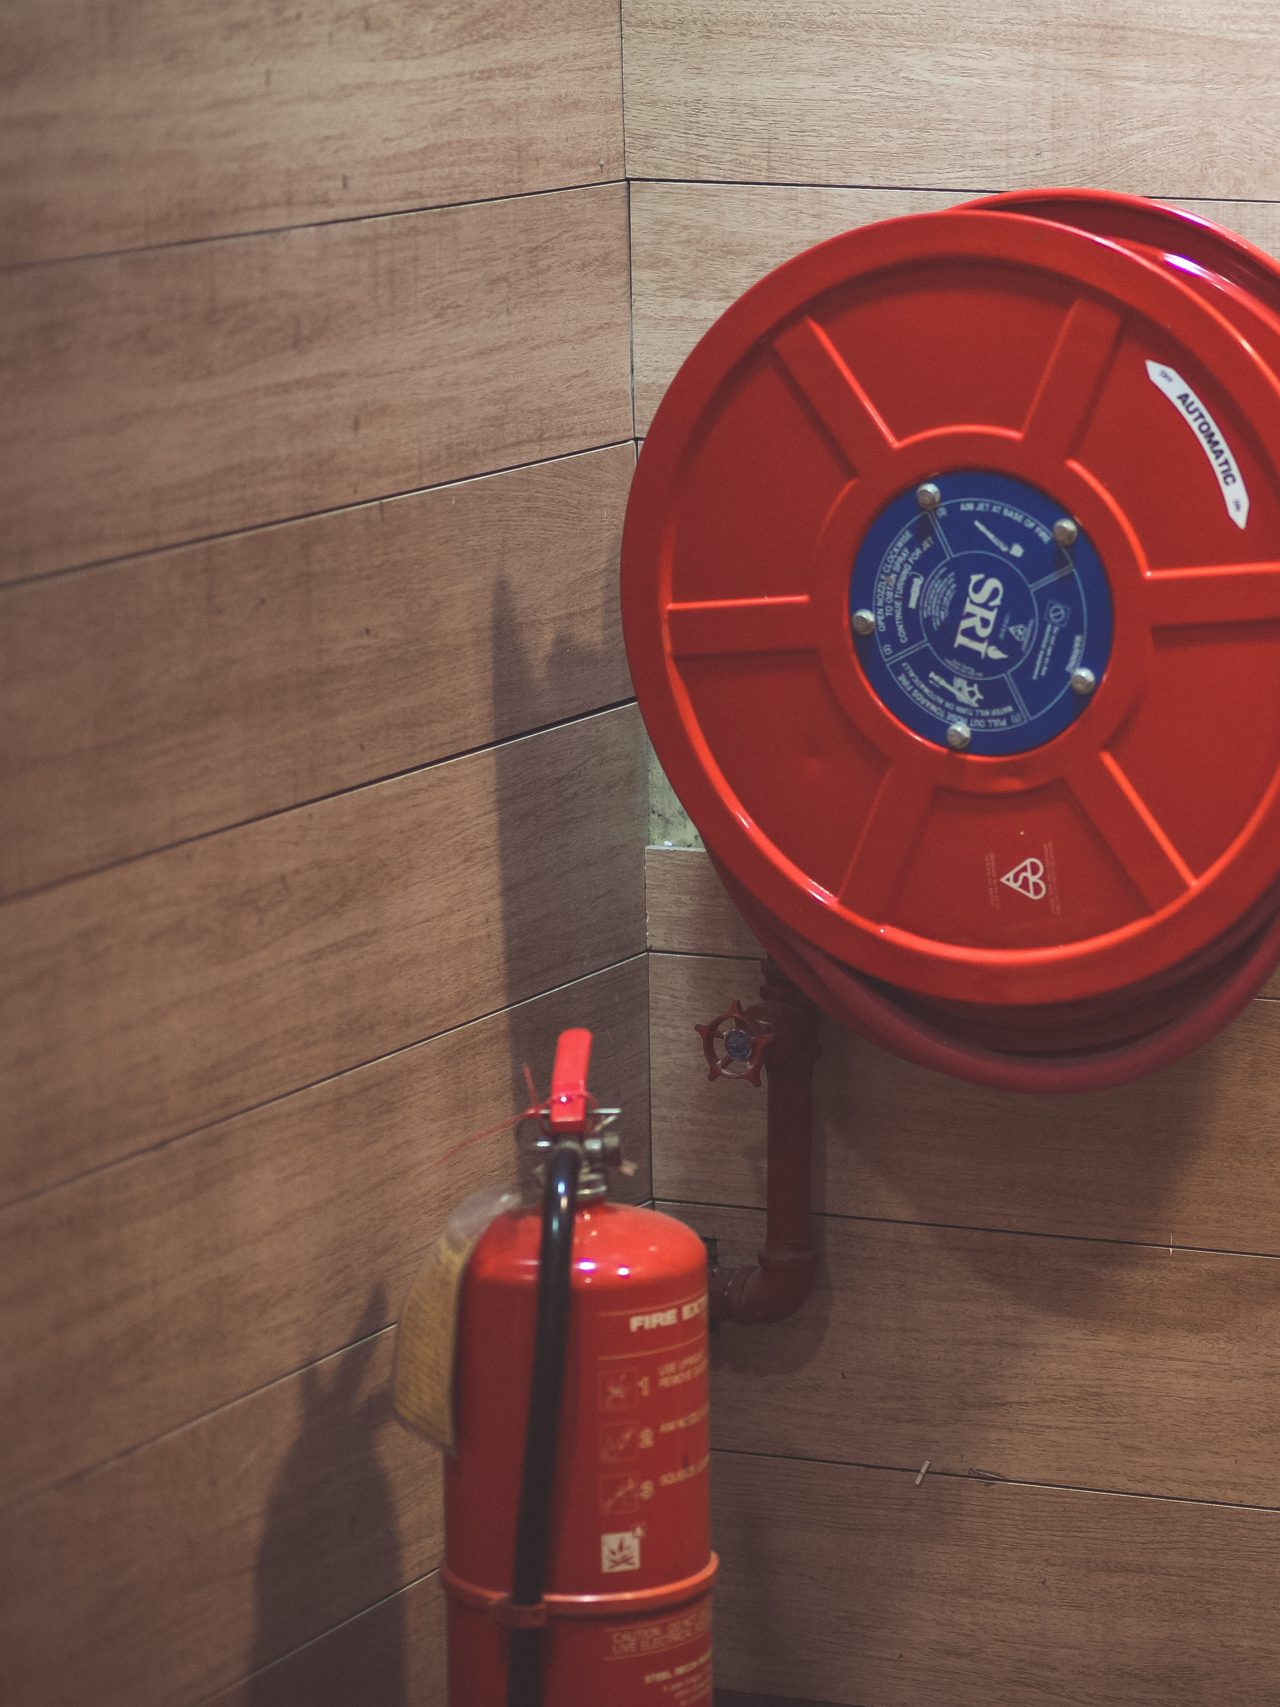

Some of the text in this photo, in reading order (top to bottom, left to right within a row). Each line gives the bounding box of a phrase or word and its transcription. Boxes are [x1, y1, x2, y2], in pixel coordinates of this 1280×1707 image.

[1177, 393, 1237, 486] AUTOMATIC
[976, 502, 990, 512] JET
[991, 504, 1001, 513] AT
[1002, 507, 1023, 523] BASE
[1023, 518, 1035, 529] OF
[1034, 526, 1051, 544] FIRE
[883, 530, 913, 572] CLOCKWISE
[877, 573, 887, 605] NOZZLE
[886, 546, 910, 615] TO OBTAIN SPRAY
[895, 535, 933, 643] CONTINUE TURNING FOR JET
[877, 608, 886, 631] OPEN
[953, 573, 1008, 660] SRI
[897, 673, 913, 691] FIRE
[901, 662, 944, 704] AUTOMATICALLY
[911, 690, 944, 717] TOWARDS
[969, 718, 985, 726] OUT
[630, 1308, 678, 1333] FIRE
[638, 1376, 650, 1396] 1
[639, 1428, 654, 1449] 2
[640, 1480, 654, 1500] 3
